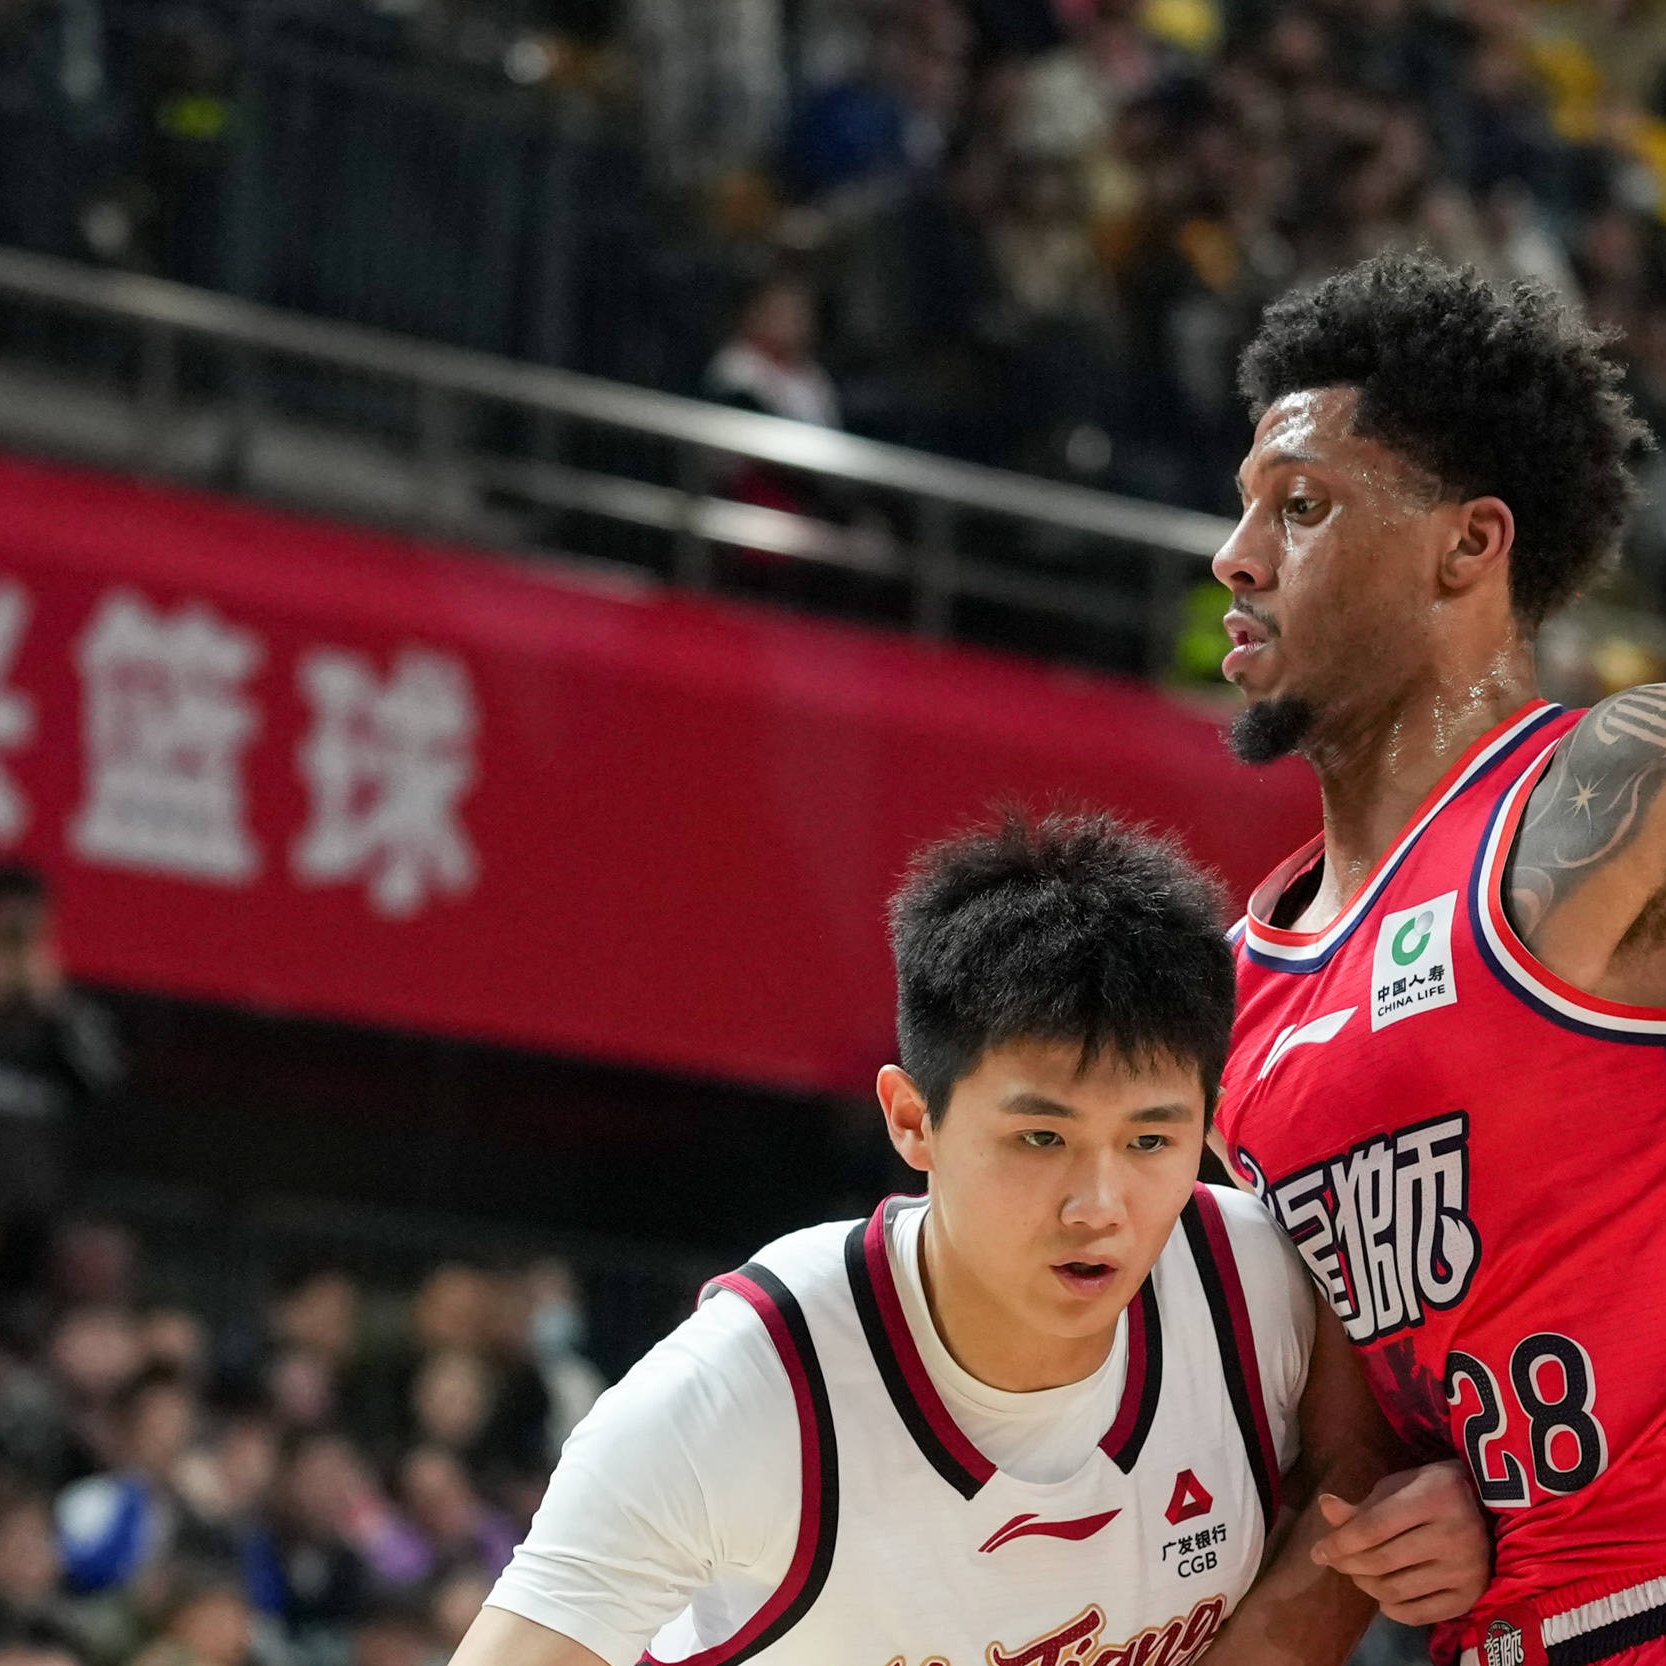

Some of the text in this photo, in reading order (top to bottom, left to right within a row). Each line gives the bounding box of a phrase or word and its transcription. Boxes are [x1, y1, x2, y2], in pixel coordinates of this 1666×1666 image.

[1377, 965, 1445, 1002] 中国人寿
[1378, 984, 1446, 1016] CHINA LIFE
[1445, 1332, 1609, 1508] 28
[1162, 1523, 1226, 1562] 广发银行
[1178, 1551, 1217, 1578] CGB
